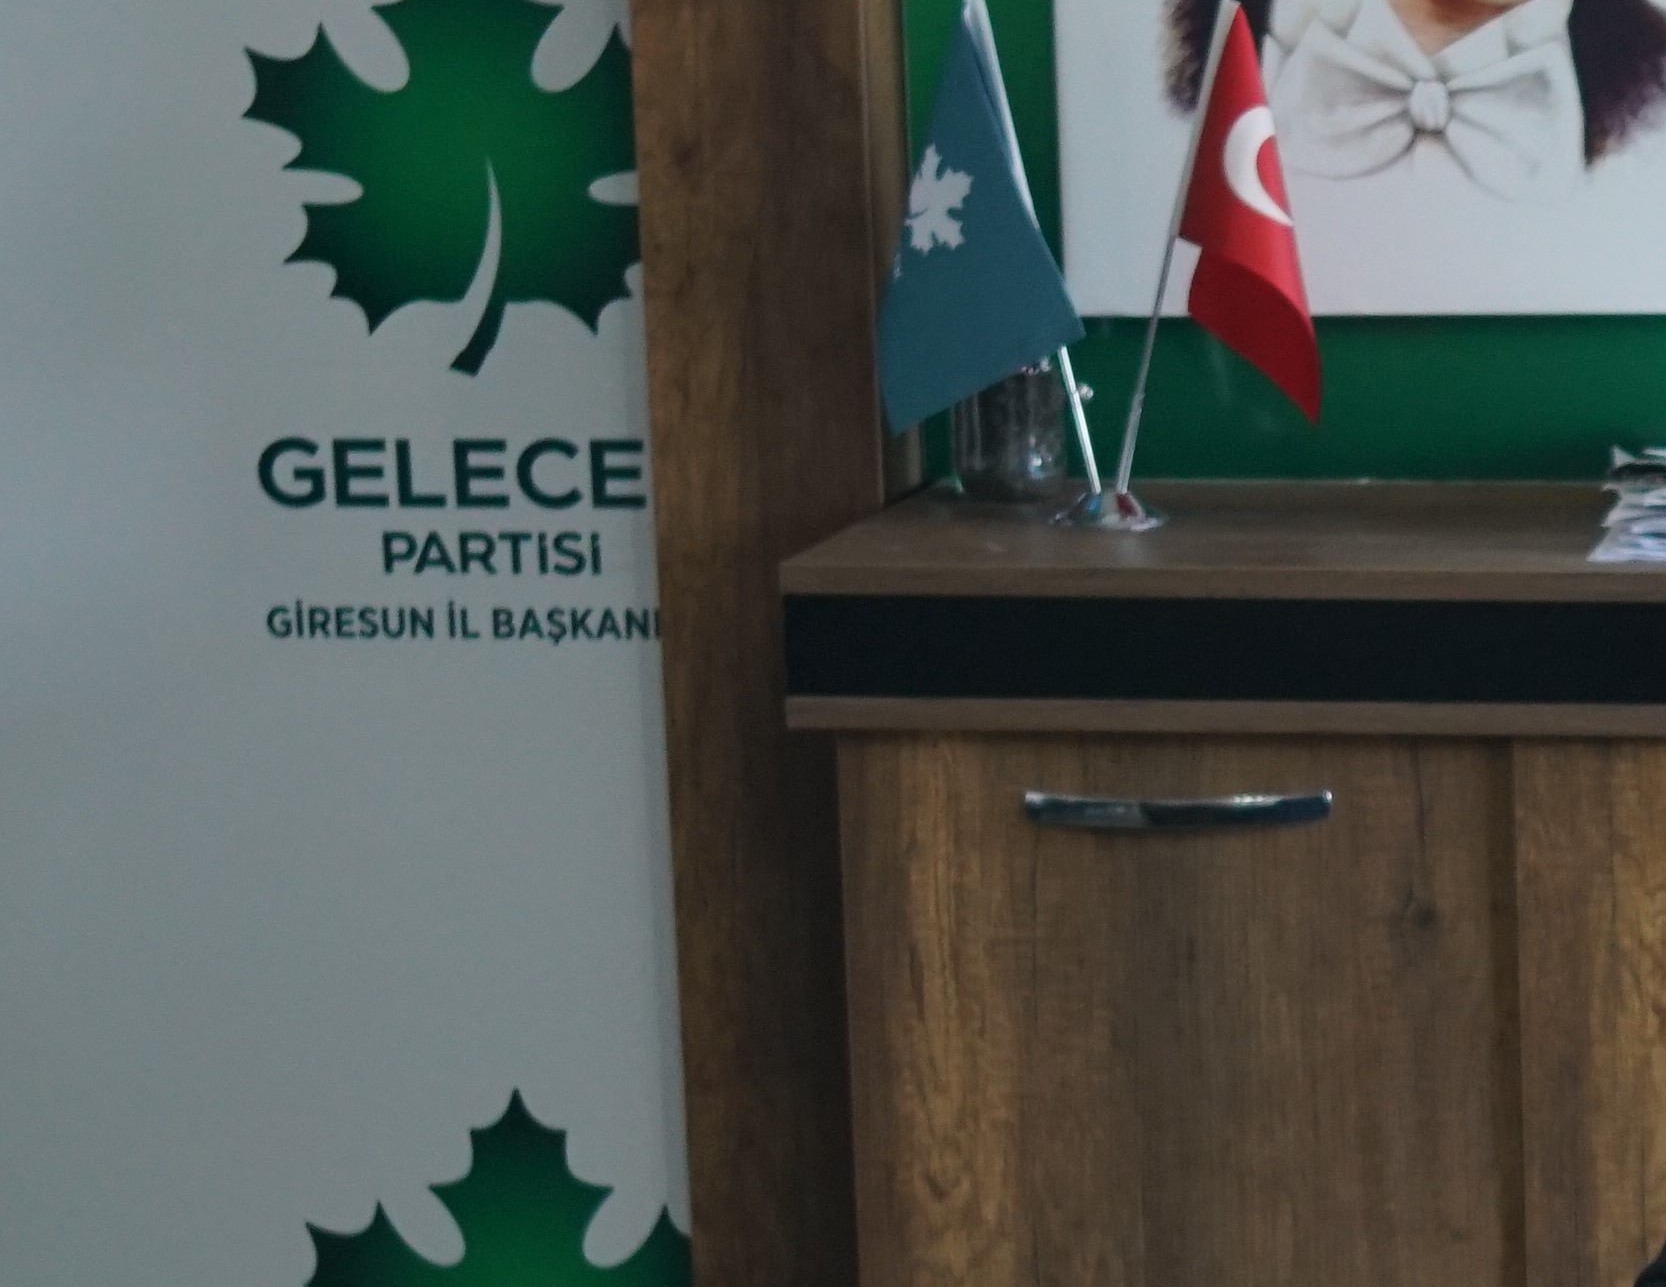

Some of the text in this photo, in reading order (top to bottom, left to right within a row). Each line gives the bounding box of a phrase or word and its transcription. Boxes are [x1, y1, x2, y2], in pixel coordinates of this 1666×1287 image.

[257, 435, 648, 510] GELECE
[266, 598, 662, 645] GİRESUN İL BAŞKAN
